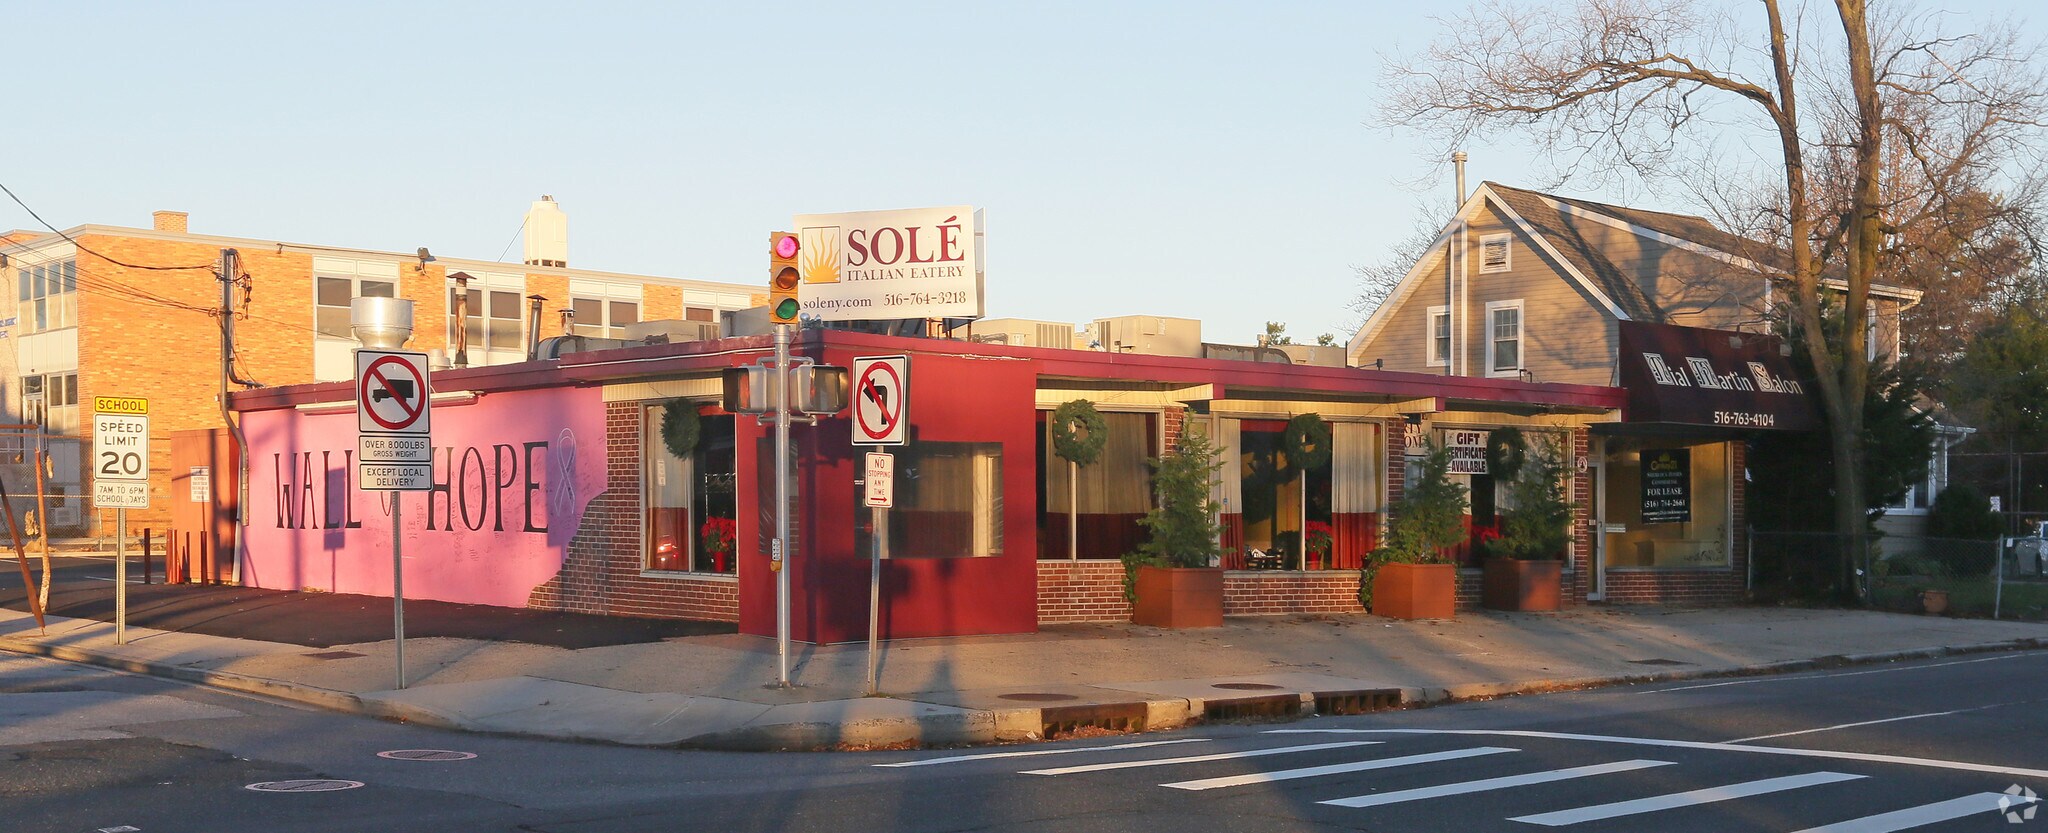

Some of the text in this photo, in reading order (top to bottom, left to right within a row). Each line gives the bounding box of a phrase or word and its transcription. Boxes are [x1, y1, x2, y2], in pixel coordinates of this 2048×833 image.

[847, 215, 965, 266] SOLÉ
[847, 266, 965, 281] ITALIAN EATERY
[803, 291, 967, 313] soleny.com 516-764-3218
[1685, 356, 1754, 392] Martin
[1747, 361, 1803, 395] Salon
[98, 399, 145, 411] SCHOOL
[1714, 411, 1774, 427] 516-763-4104
[100, 422, 143, 433] SPEED
[105, 436, 138, 446] LIMIT
[1456, 432, 1480, 445] GIFT
[365, 440, 385, 449] OVER
[395, 450, 417, 458] WEIGHT
[1450, 447, 1487, 459] ERTIFICATE
[101, 451, 142, 475] 20
[874, 459, 885, 469] NO
[1451, 460, 1486, 473] AVAILABLE
[367, 468, 424, 477] EXCEPT LOCAL
[869, 470, 891, 478] STOPPING
[274, 449, 362, 530] WALL
[426, 441, 549, 533] HOPE
[376, 478, 415, 487] DELIVERY
[99, 486, 144, 495] 7AM TO 6PM
[874, 488, 885, 496] TIME
[1647, 487, 1683, 496] FOR LEASE
[97, 495, 124, 503] SCHOOL
